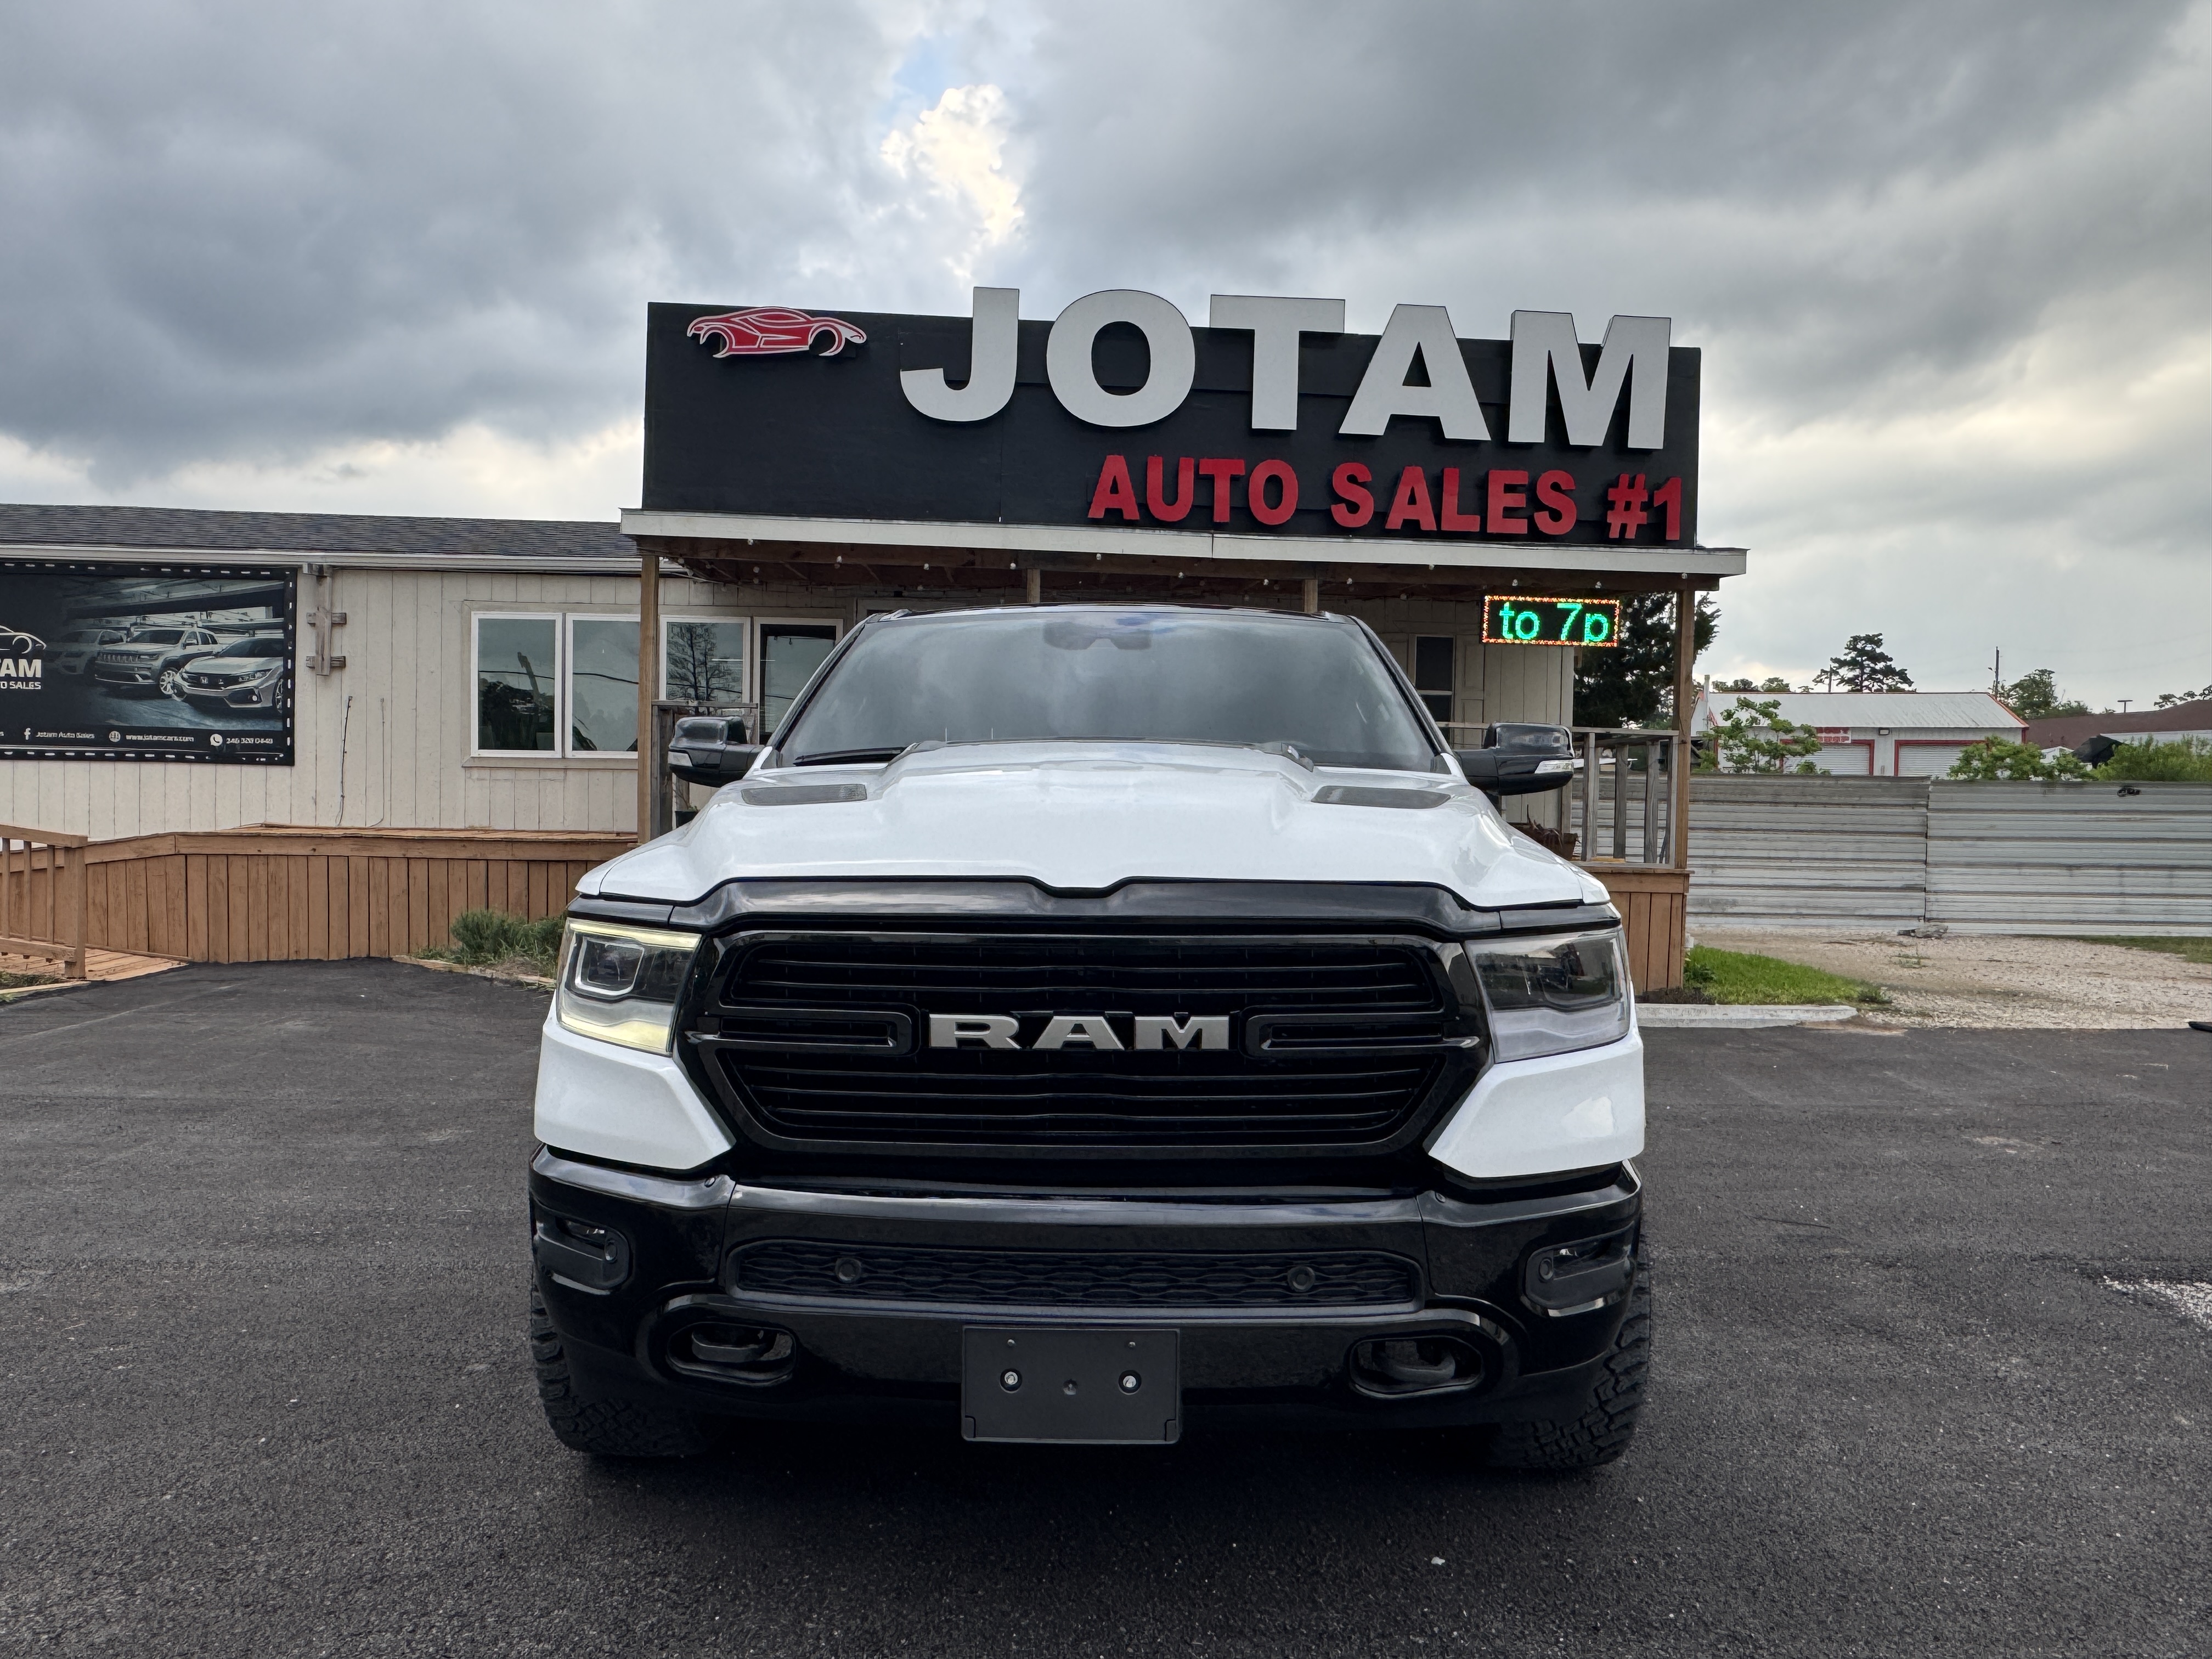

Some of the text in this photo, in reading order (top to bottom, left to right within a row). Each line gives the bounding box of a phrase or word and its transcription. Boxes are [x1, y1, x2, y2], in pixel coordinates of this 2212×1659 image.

[900, 286, 1671, 449] JOTAM
[1087, 454, 1682, 540] AUTO SALES #1
[1499, 602, 1609, 643] to 7p
[0, 658, 42, 678] AM
[929, 1013, 1229, 1050] RAM
